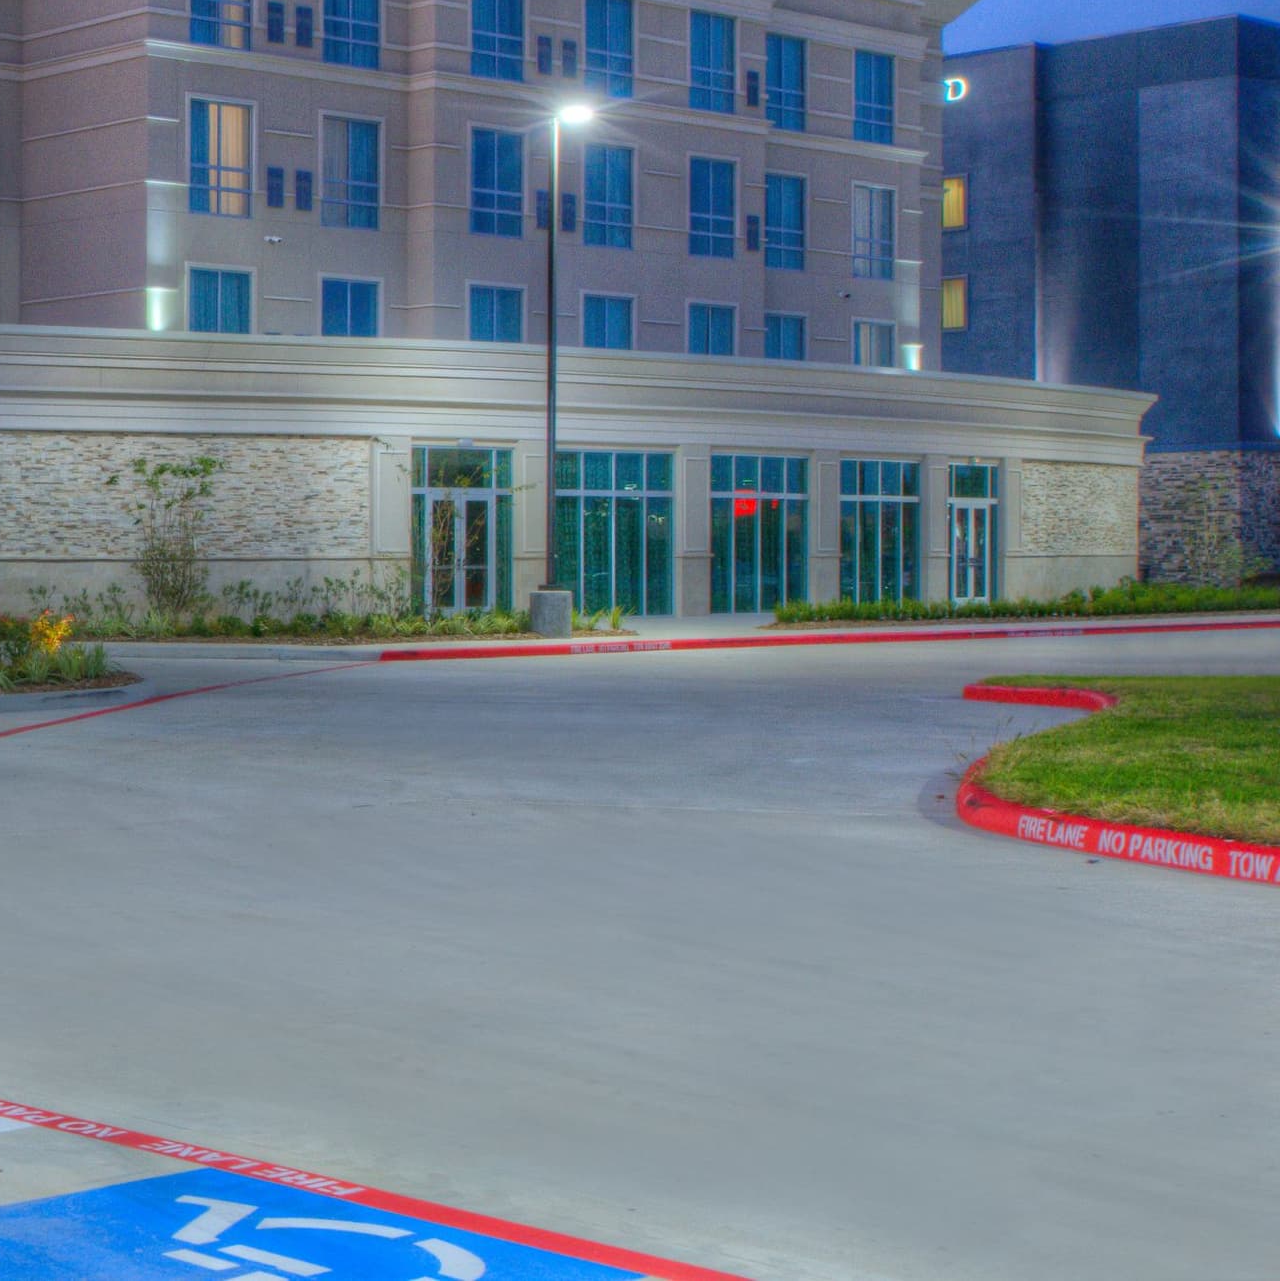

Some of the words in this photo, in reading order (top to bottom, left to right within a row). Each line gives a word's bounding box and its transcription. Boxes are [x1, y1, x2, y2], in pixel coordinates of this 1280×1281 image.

[1018, 815, 1046, 840] FIRE
[1046, 820, 1089, 847] LANE
[1098, 829, 1125, 854] NO
[1129, 834, 1213, 870] PARKING
[1229, 851, 1274, 880] TOW
[57, 1121, 128, 1138] NO
[140, 1140, 260, 1170] LANE
[251, 1167, 365, 1196] FIRE
